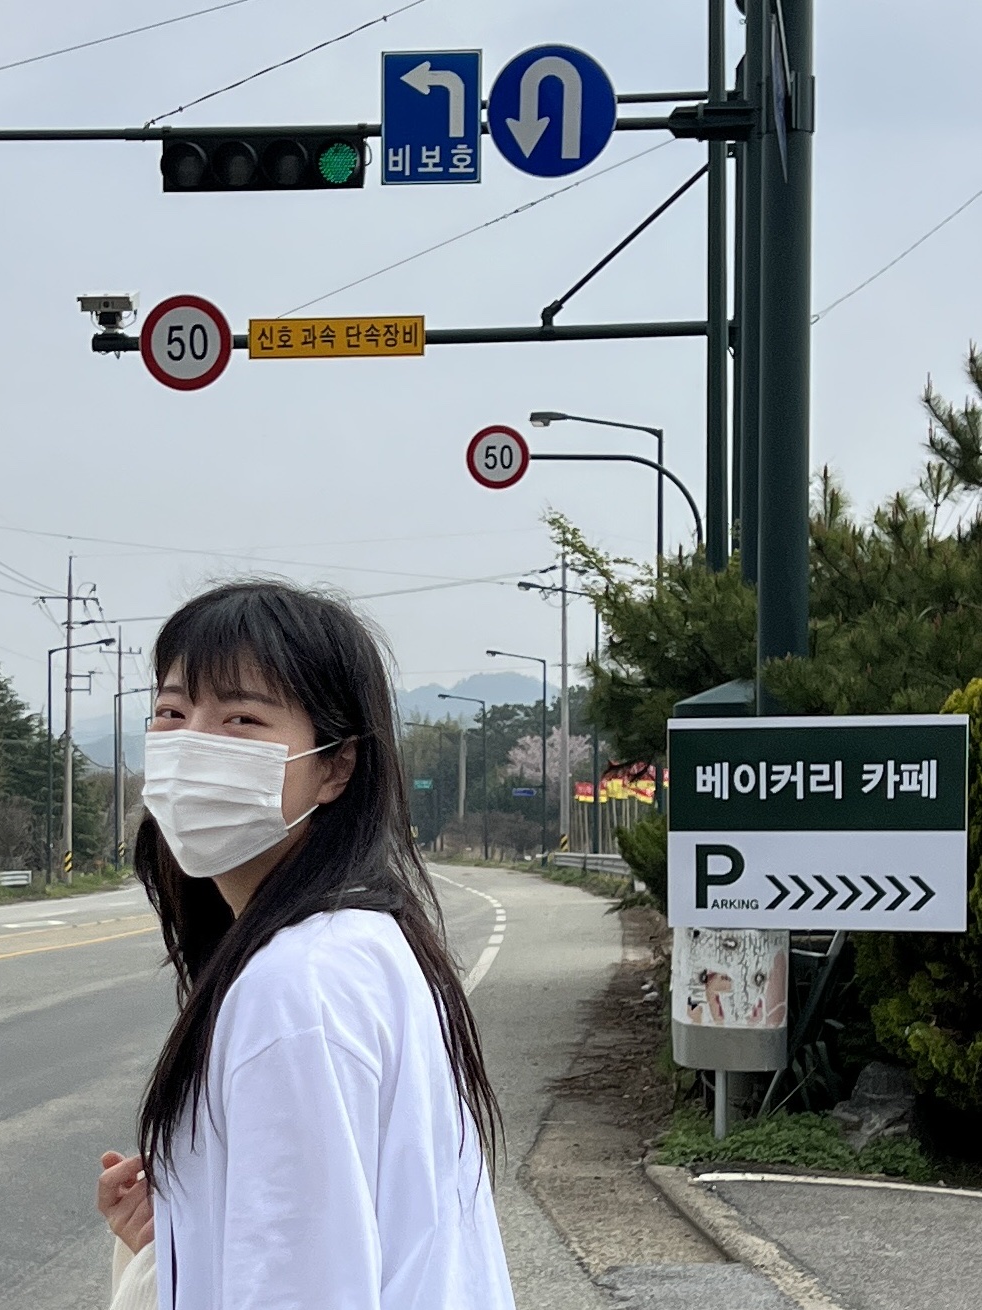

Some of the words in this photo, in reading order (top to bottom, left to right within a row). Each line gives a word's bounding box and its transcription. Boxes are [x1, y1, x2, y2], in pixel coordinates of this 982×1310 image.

[388, 143, 475, 176] 비보호
[166, 323, 209, 362] 50
[257, 325, 294, 351] 신호
[301, 324, 337, 350] 과속
[345, 321, 418, 348] 단속장비
[483, 444, 515, 471] 50
[695, 760, 843, 801] 베이커리
[861, 759, 938, 800] 카페
